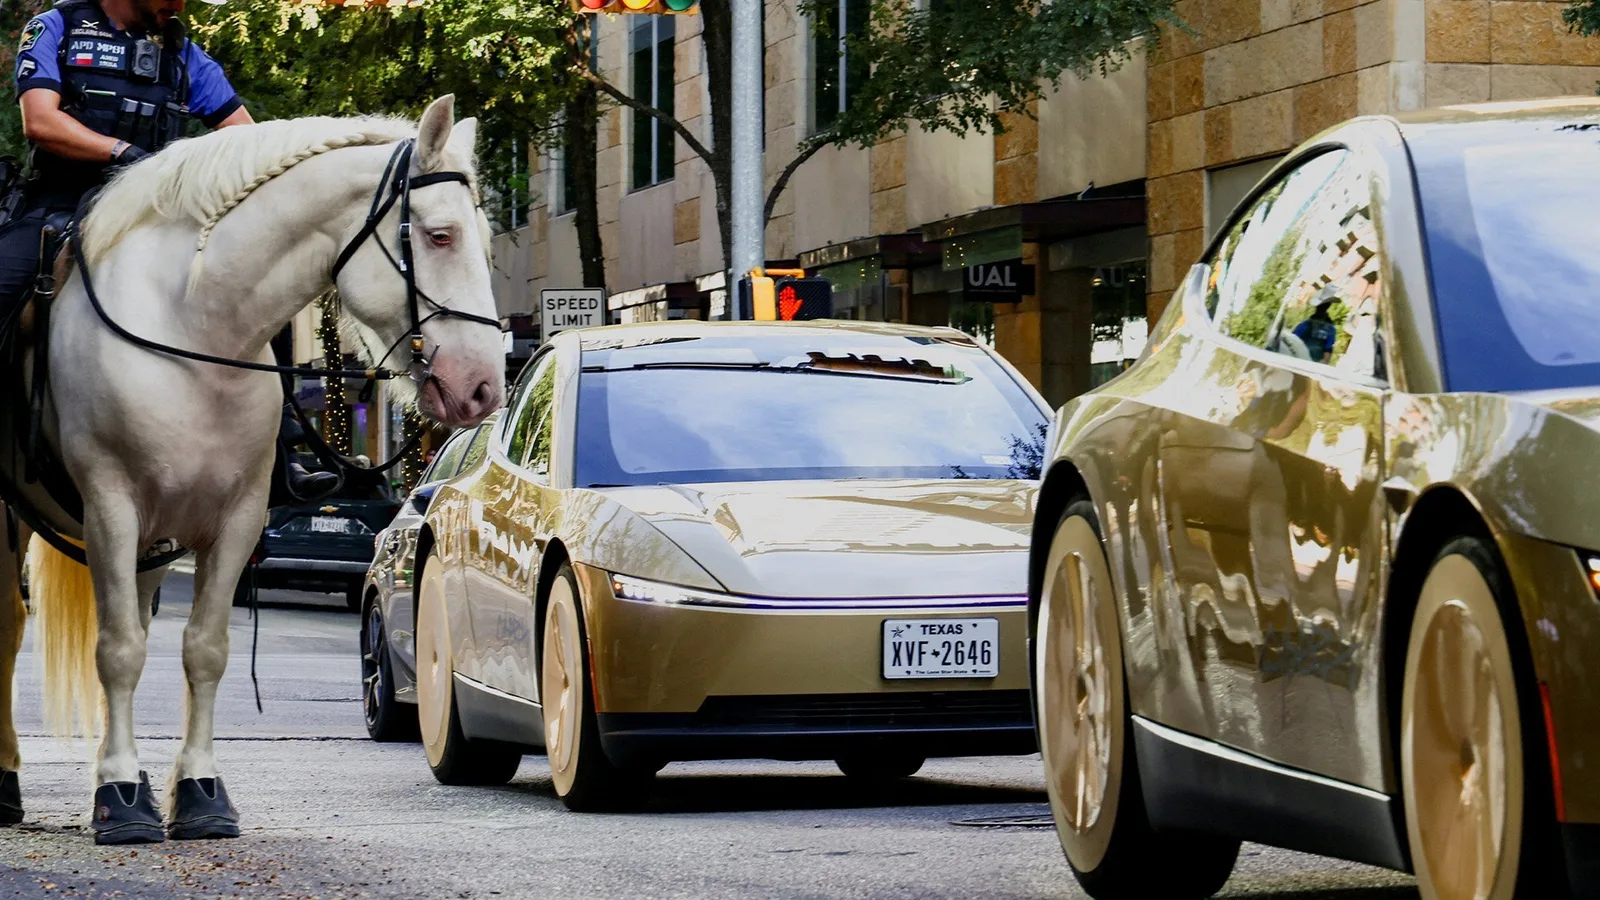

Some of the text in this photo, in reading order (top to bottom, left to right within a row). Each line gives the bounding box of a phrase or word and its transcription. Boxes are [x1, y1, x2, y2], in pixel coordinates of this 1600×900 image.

[71, 41, 93, 50] APD
[546, 297, 599, 310] SPEED
[552, 314, 592, 326] LIMIT
[920, 624, 963, 635] TEXAS
[892, 640, 991, 666] XVF 2646
